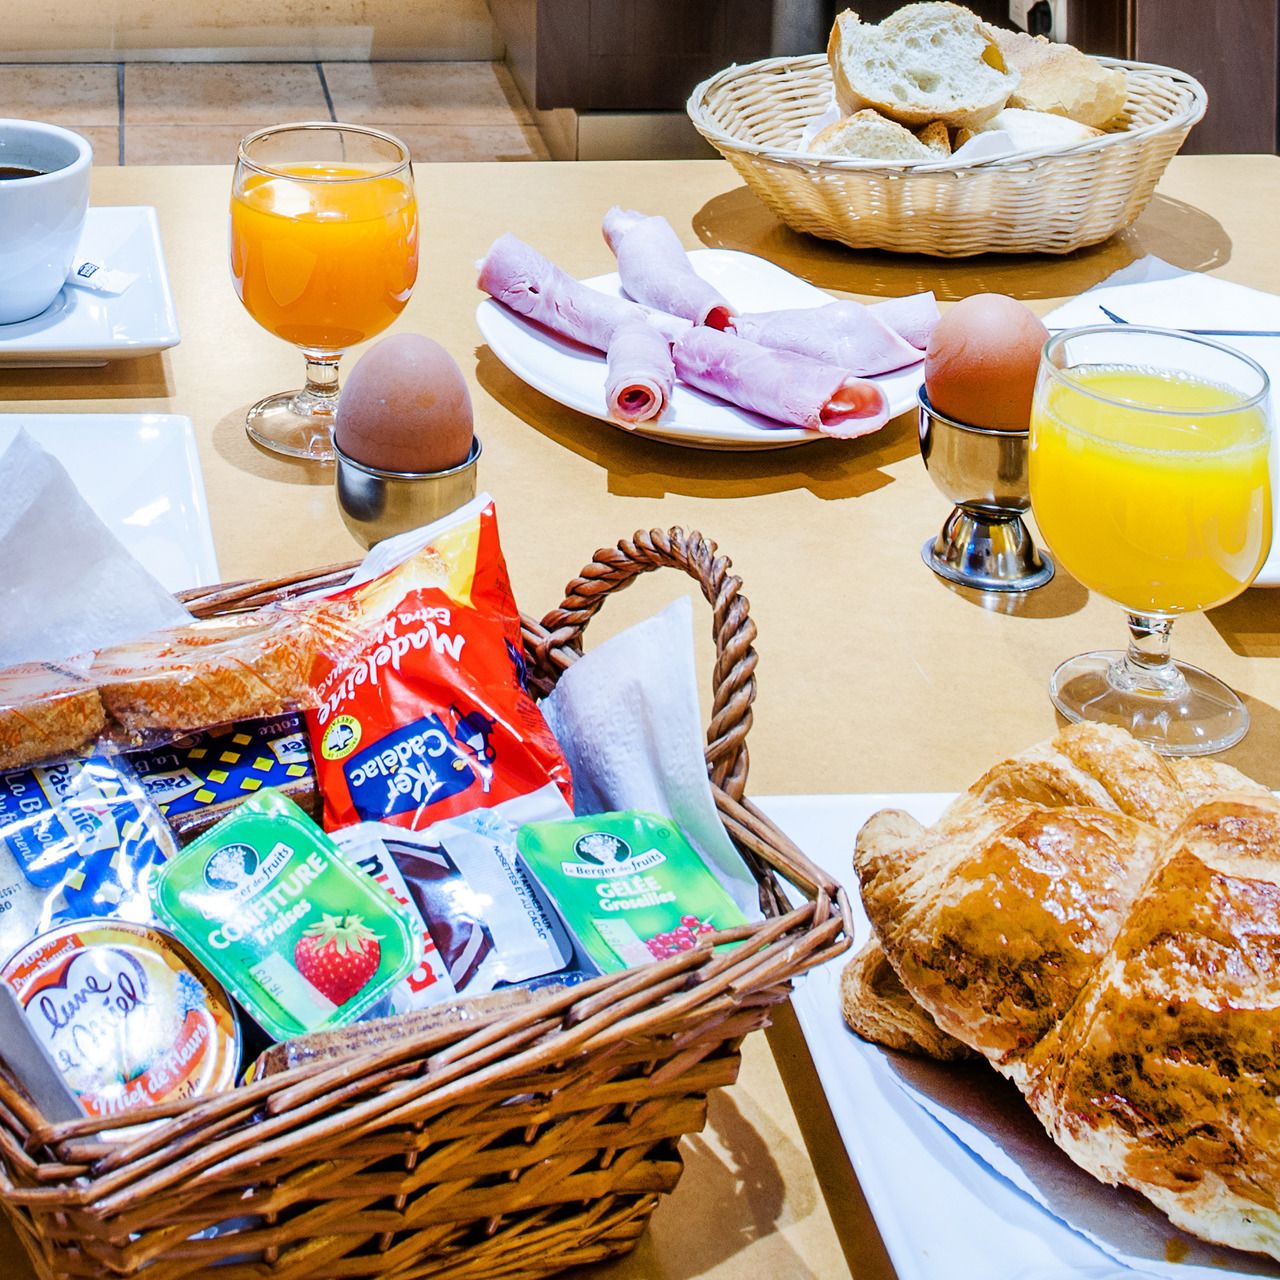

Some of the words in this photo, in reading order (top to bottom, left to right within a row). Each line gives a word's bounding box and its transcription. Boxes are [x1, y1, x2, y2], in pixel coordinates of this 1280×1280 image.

[398, 607, 451, 626] Extra
[317, 621, 466, 725] Madeleine
[349, 729, 448, 787] Cadélac
[4, 771, 25, 798] La
[384, 762, 437, 804] Ker
[263, 847, 290, 880] fruits
[575, 864, 616, 876] Berger
[631, 852, 662, 873] fruits
[595, 873, 662, 899] GELÉE
[207, 851, 328, 950] CONFITURE
[493, 846, 519, 888] NOISETTES
[527, 909, 548, 941] CACAO
[519, 871, 544, 914] TARTINER
[539, 910, 554, 931] AUX
[598, 889, 677, 912] Groseilles
[254, 897, 313, 946] Fraises
[146, 1068, 169, 1094] de
[164, 1024, 208, 1077] Fleurs
